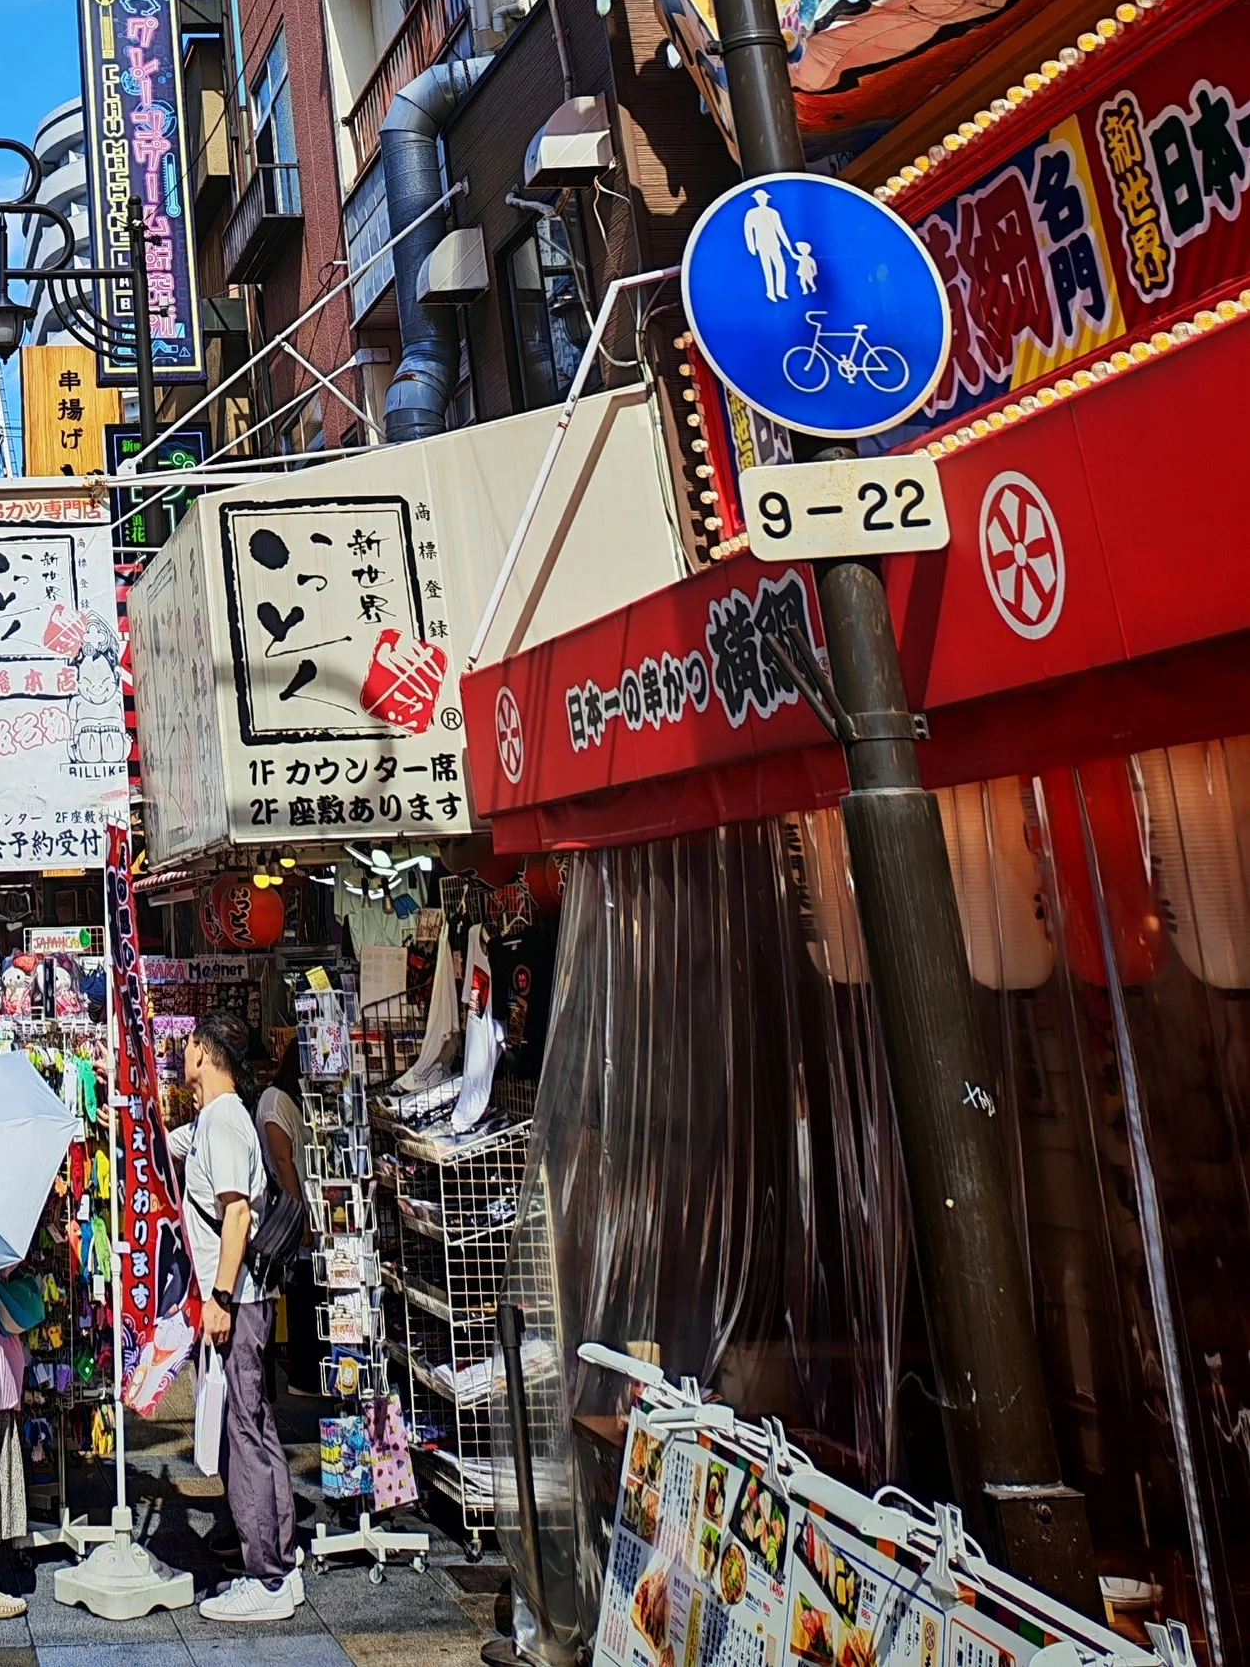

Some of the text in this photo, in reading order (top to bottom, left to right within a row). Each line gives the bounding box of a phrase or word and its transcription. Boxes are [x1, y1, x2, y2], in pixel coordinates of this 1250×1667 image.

[102, 64, 125, 137] CLAW
[1102, 98, 1174, 293] 新世界
[1152, 82, 1250, 240] 日本
[1034, 151, 1110, 336] 名門
[110, 247, 136, 317] LAB
[58, 370, 85, 449] 串揚げ
[132, 515, 146, 543] 浪花
[758, 478, 931, 539] 9-22
[40, 552, 64, 602] 新世界
[347, 529, 397, 624] 新世界
[414, 502, 450, 639] 商標登録
[707, 574, 817, 724] 横綱
[566, 651, 707, 750] 日本一の串かつ
[249, 753, 459, 786] 1F カウンター席
[250, 792, 463, 827] 2F 座敷あります
[146, 961, 186, 979] SAKA
